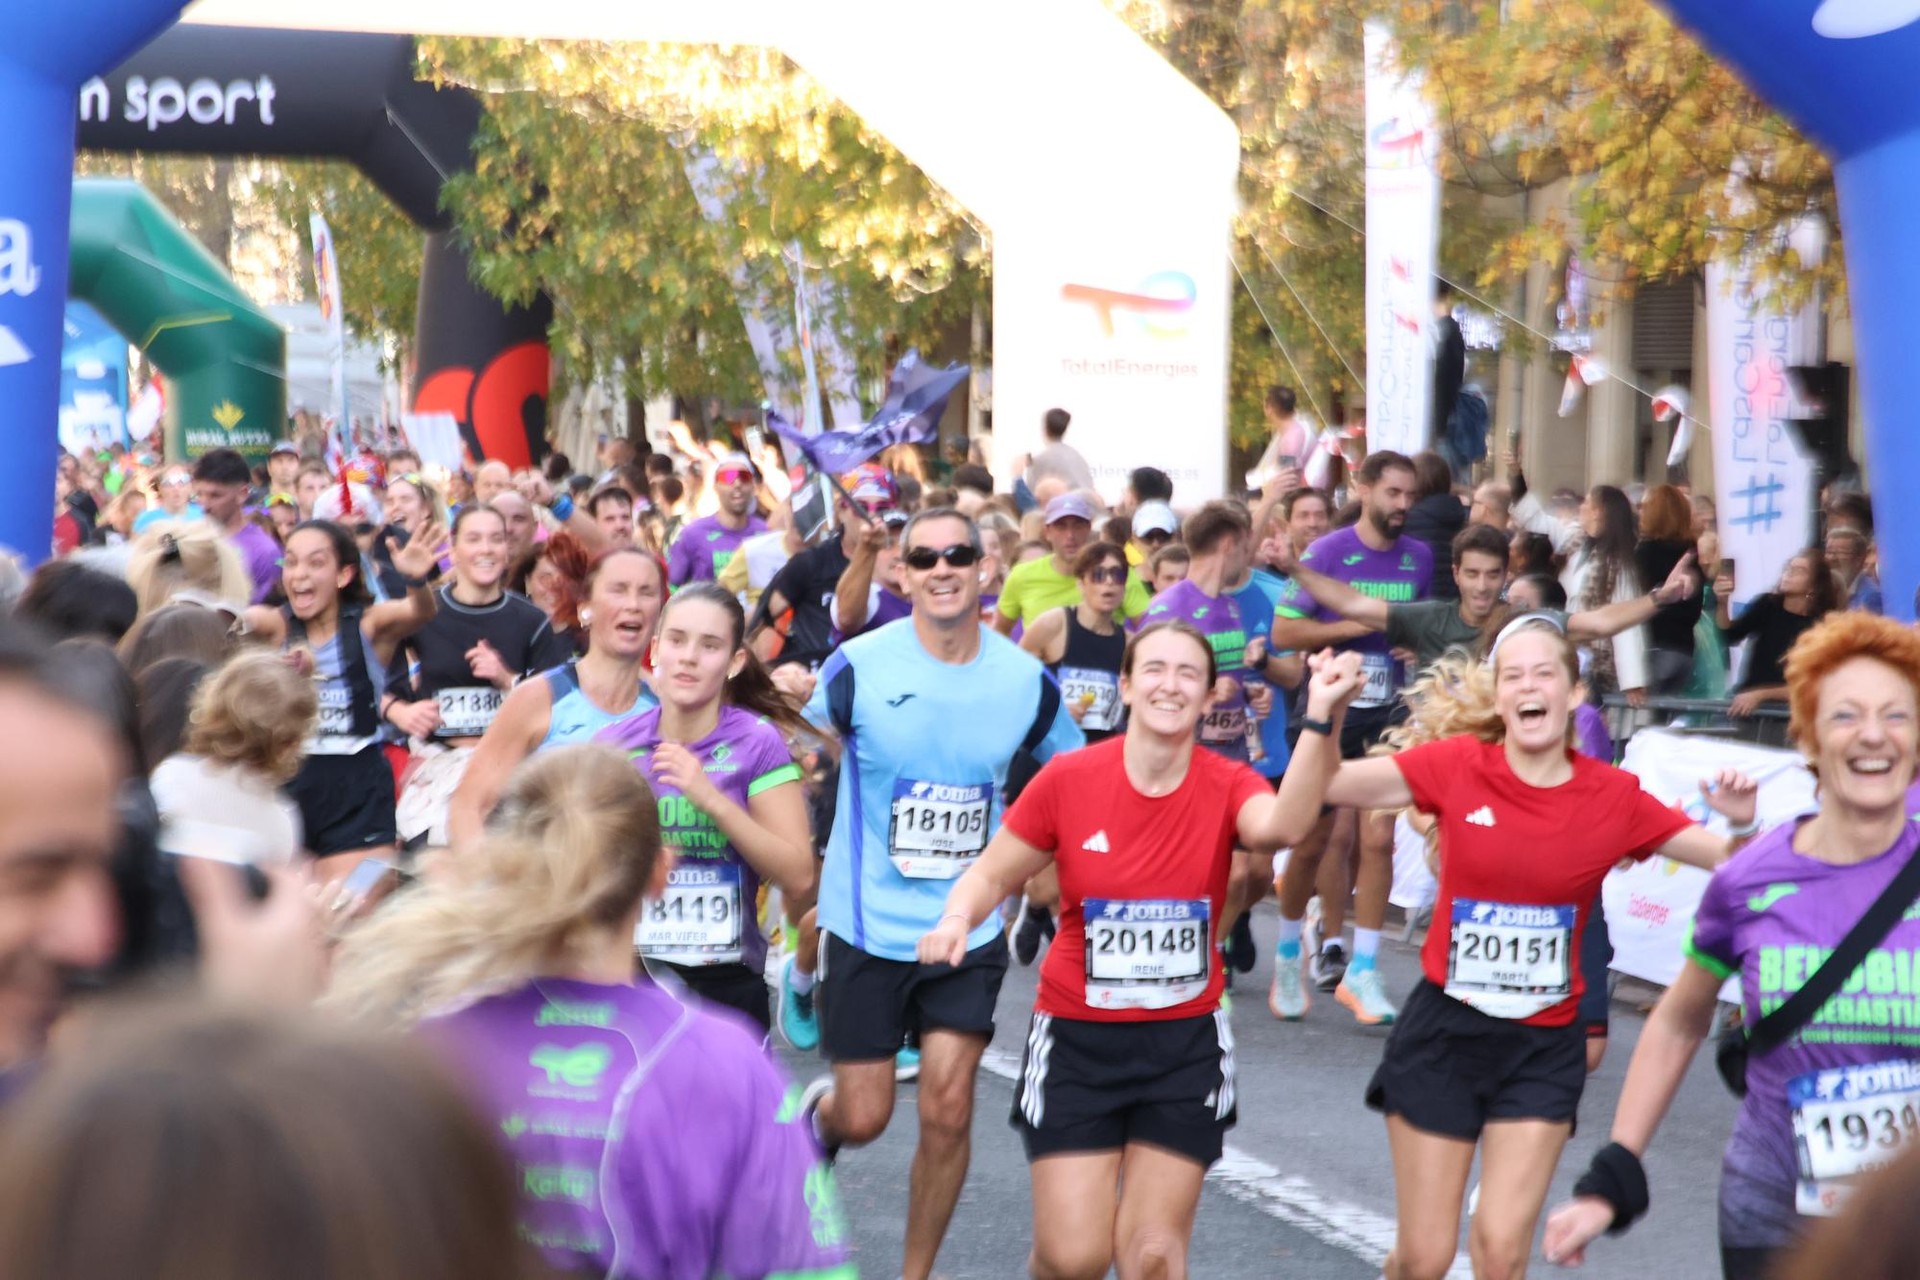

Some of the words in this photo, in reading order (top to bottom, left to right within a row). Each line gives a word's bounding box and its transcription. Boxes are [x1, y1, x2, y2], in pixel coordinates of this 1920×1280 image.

[123, 74, 277, 131] sport
[1060, 358, 1200, 381] TotalEnergies
[902, 806, 984, 834] 18105
[666, 868, 720, 885] oma
[1097, 928, 1196, 955] 20148
[1462, 932, 1559, 965] 20151
[1131, 964, 1165, 975] IRENE
